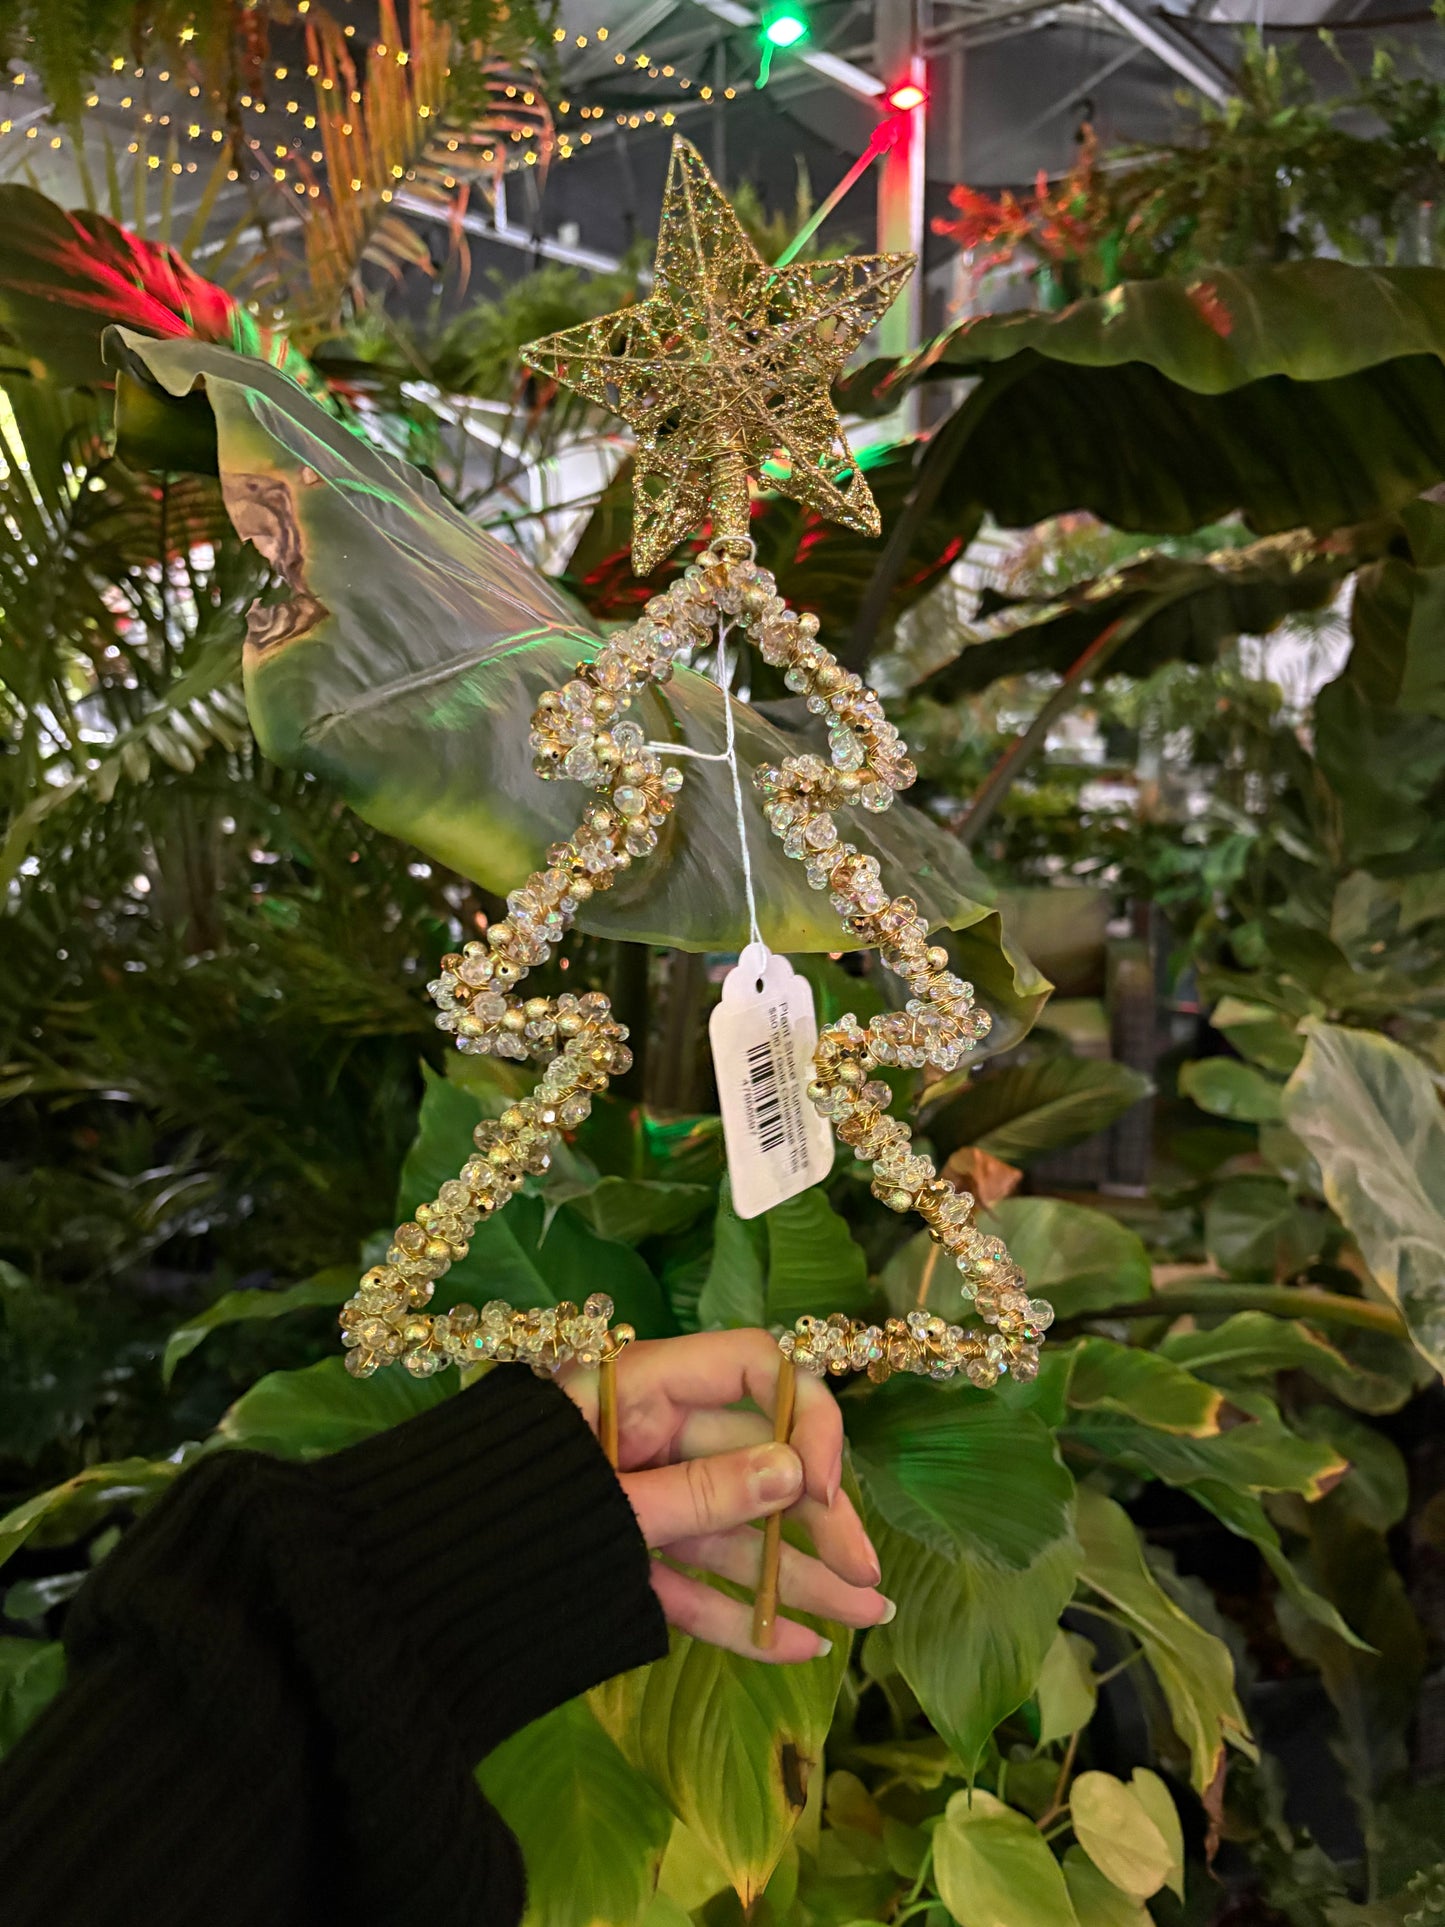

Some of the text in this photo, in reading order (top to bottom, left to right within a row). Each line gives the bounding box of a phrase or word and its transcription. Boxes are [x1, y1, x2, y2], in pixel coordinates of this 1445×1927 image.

[779, 1002, 791, 1037] Plant
[784, 1041, 796, 1080] Stake
[780, 1087, 794, 1145] Christmas
